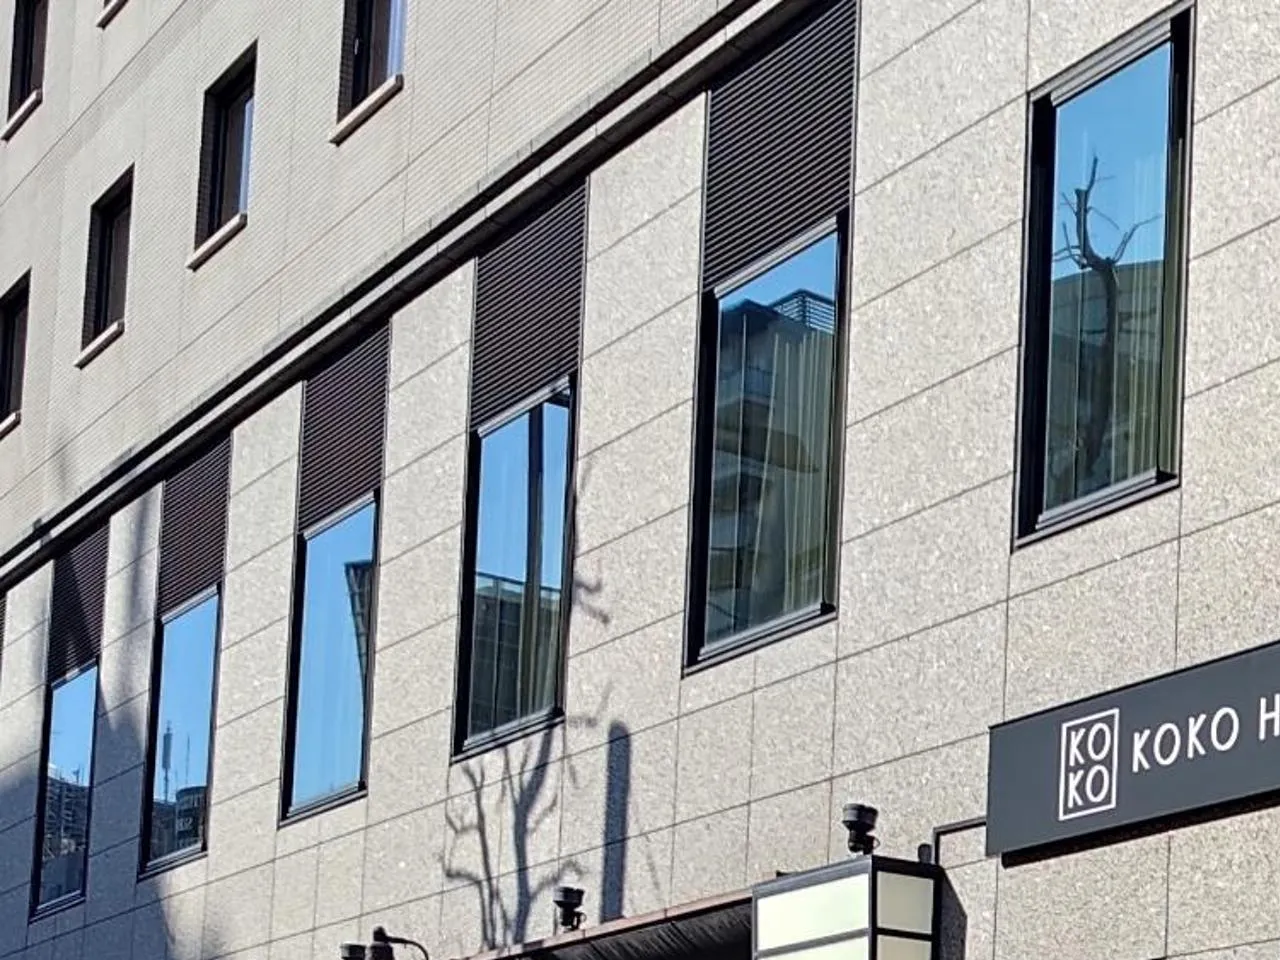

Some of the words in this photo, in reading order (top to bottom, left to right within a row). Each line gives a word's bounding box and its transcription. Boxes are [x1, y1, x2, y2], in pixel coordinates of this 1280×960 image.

[1069, 722, 1112, 767] KO
[1132, 707, 1239, 773] KOKO
[1067, 764, 1110, 809] KO
